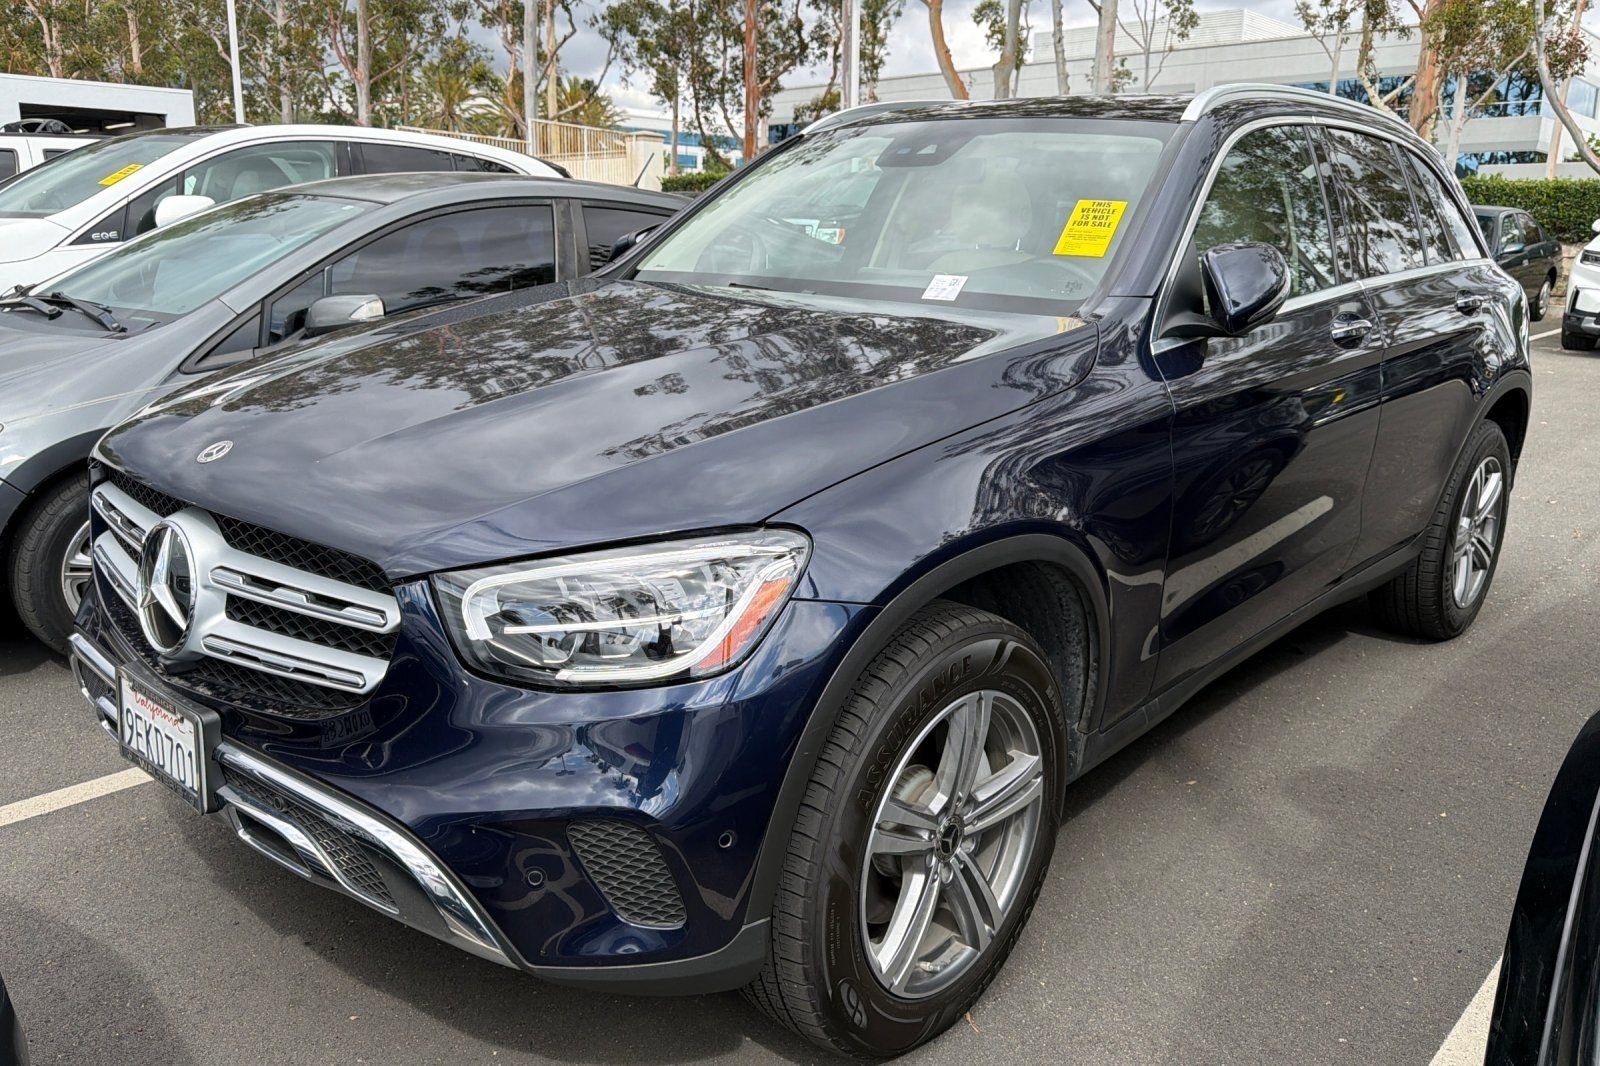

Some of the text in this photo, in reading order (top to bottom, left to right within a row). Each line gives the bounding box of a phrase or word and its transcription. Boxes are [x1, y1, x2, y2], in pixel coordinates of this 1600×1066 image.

[91, 230, 119, 241] EQE
[1090, 220, 1113, 228] SALE
[125, 707, 199, 792] 9EKD701
[856, 653, 972, 813] ASSURANCE
